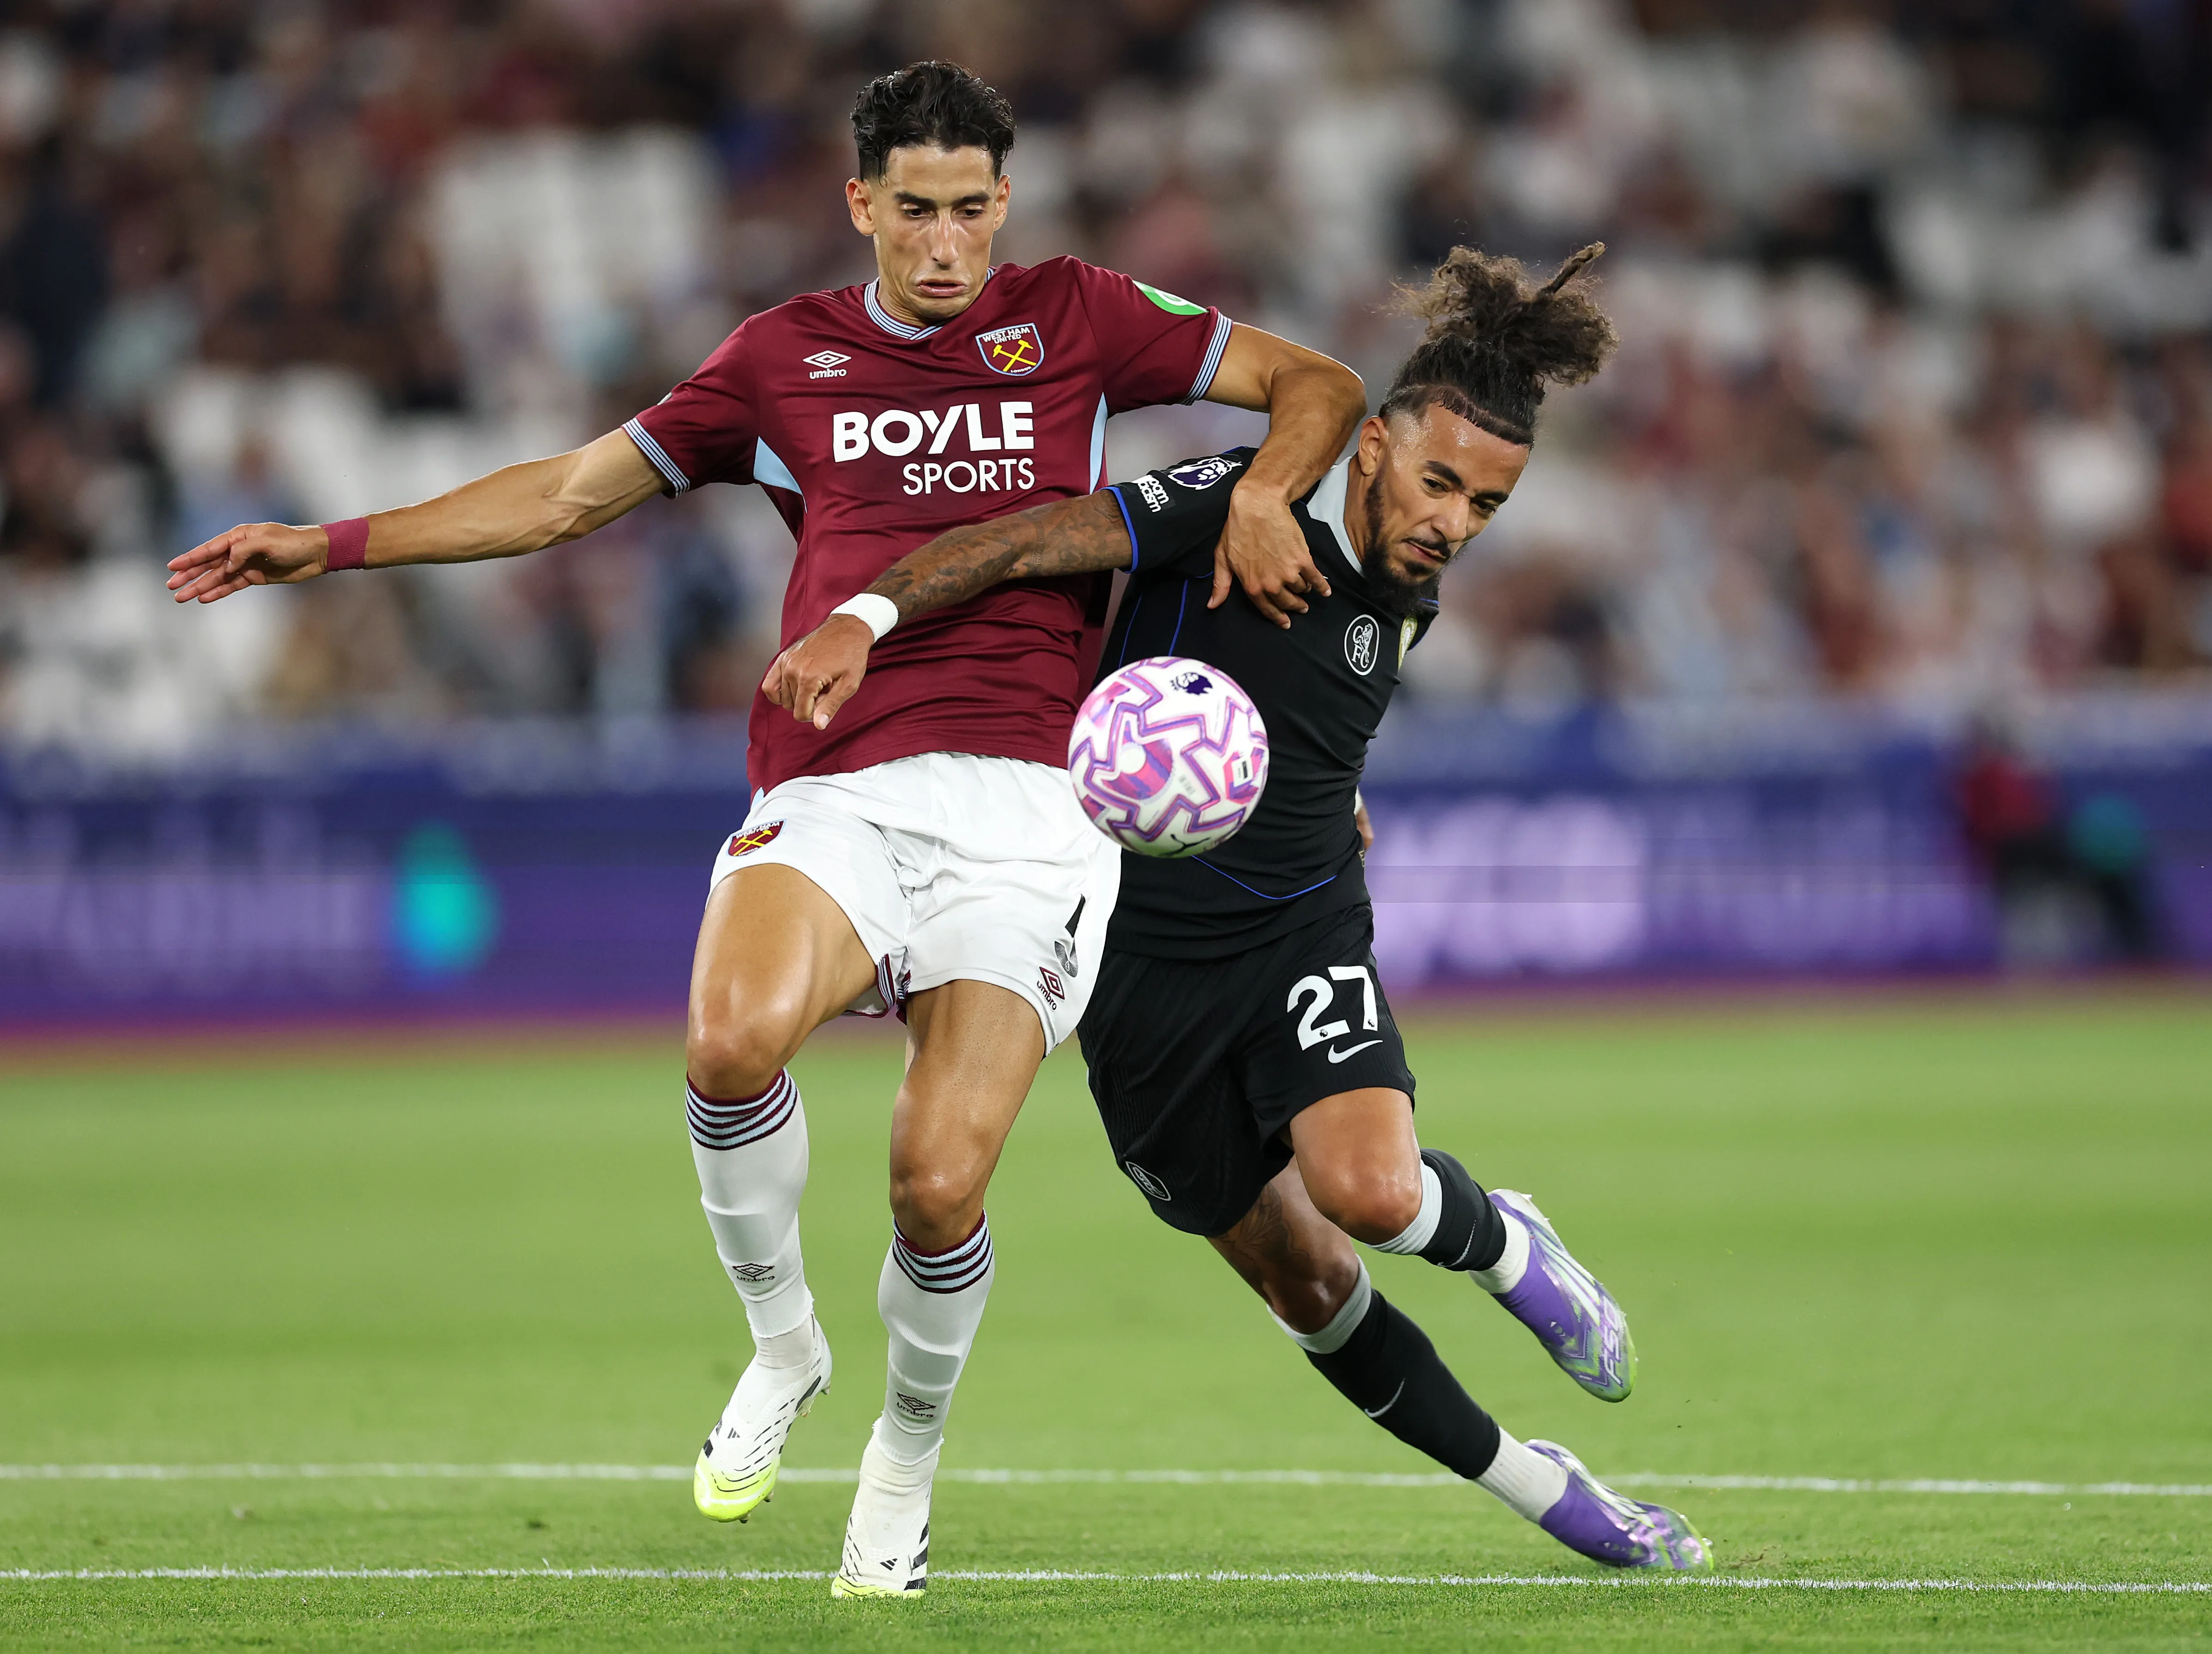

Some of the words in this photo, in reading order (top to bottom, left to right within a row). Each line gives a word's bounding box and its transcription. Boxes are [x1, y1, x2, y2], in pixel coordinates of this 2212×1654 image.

[982, 330, 1006, 342] WEST
[1007, 327, 1030, 336] HAM
[994, 334, 1022, 344] UNITED
[809, 368, 847, 379] umbro
[833, 401, 1034, 462] BOYLE
[903, 457, 1035, 495] SPORTS
[1136, 481, 1161, 512] acism
[1036, 980, 1057, 1010] umbro
[1287, 965, 1378, 1051] 27
[897, 1402, 934, 1418] umbro
